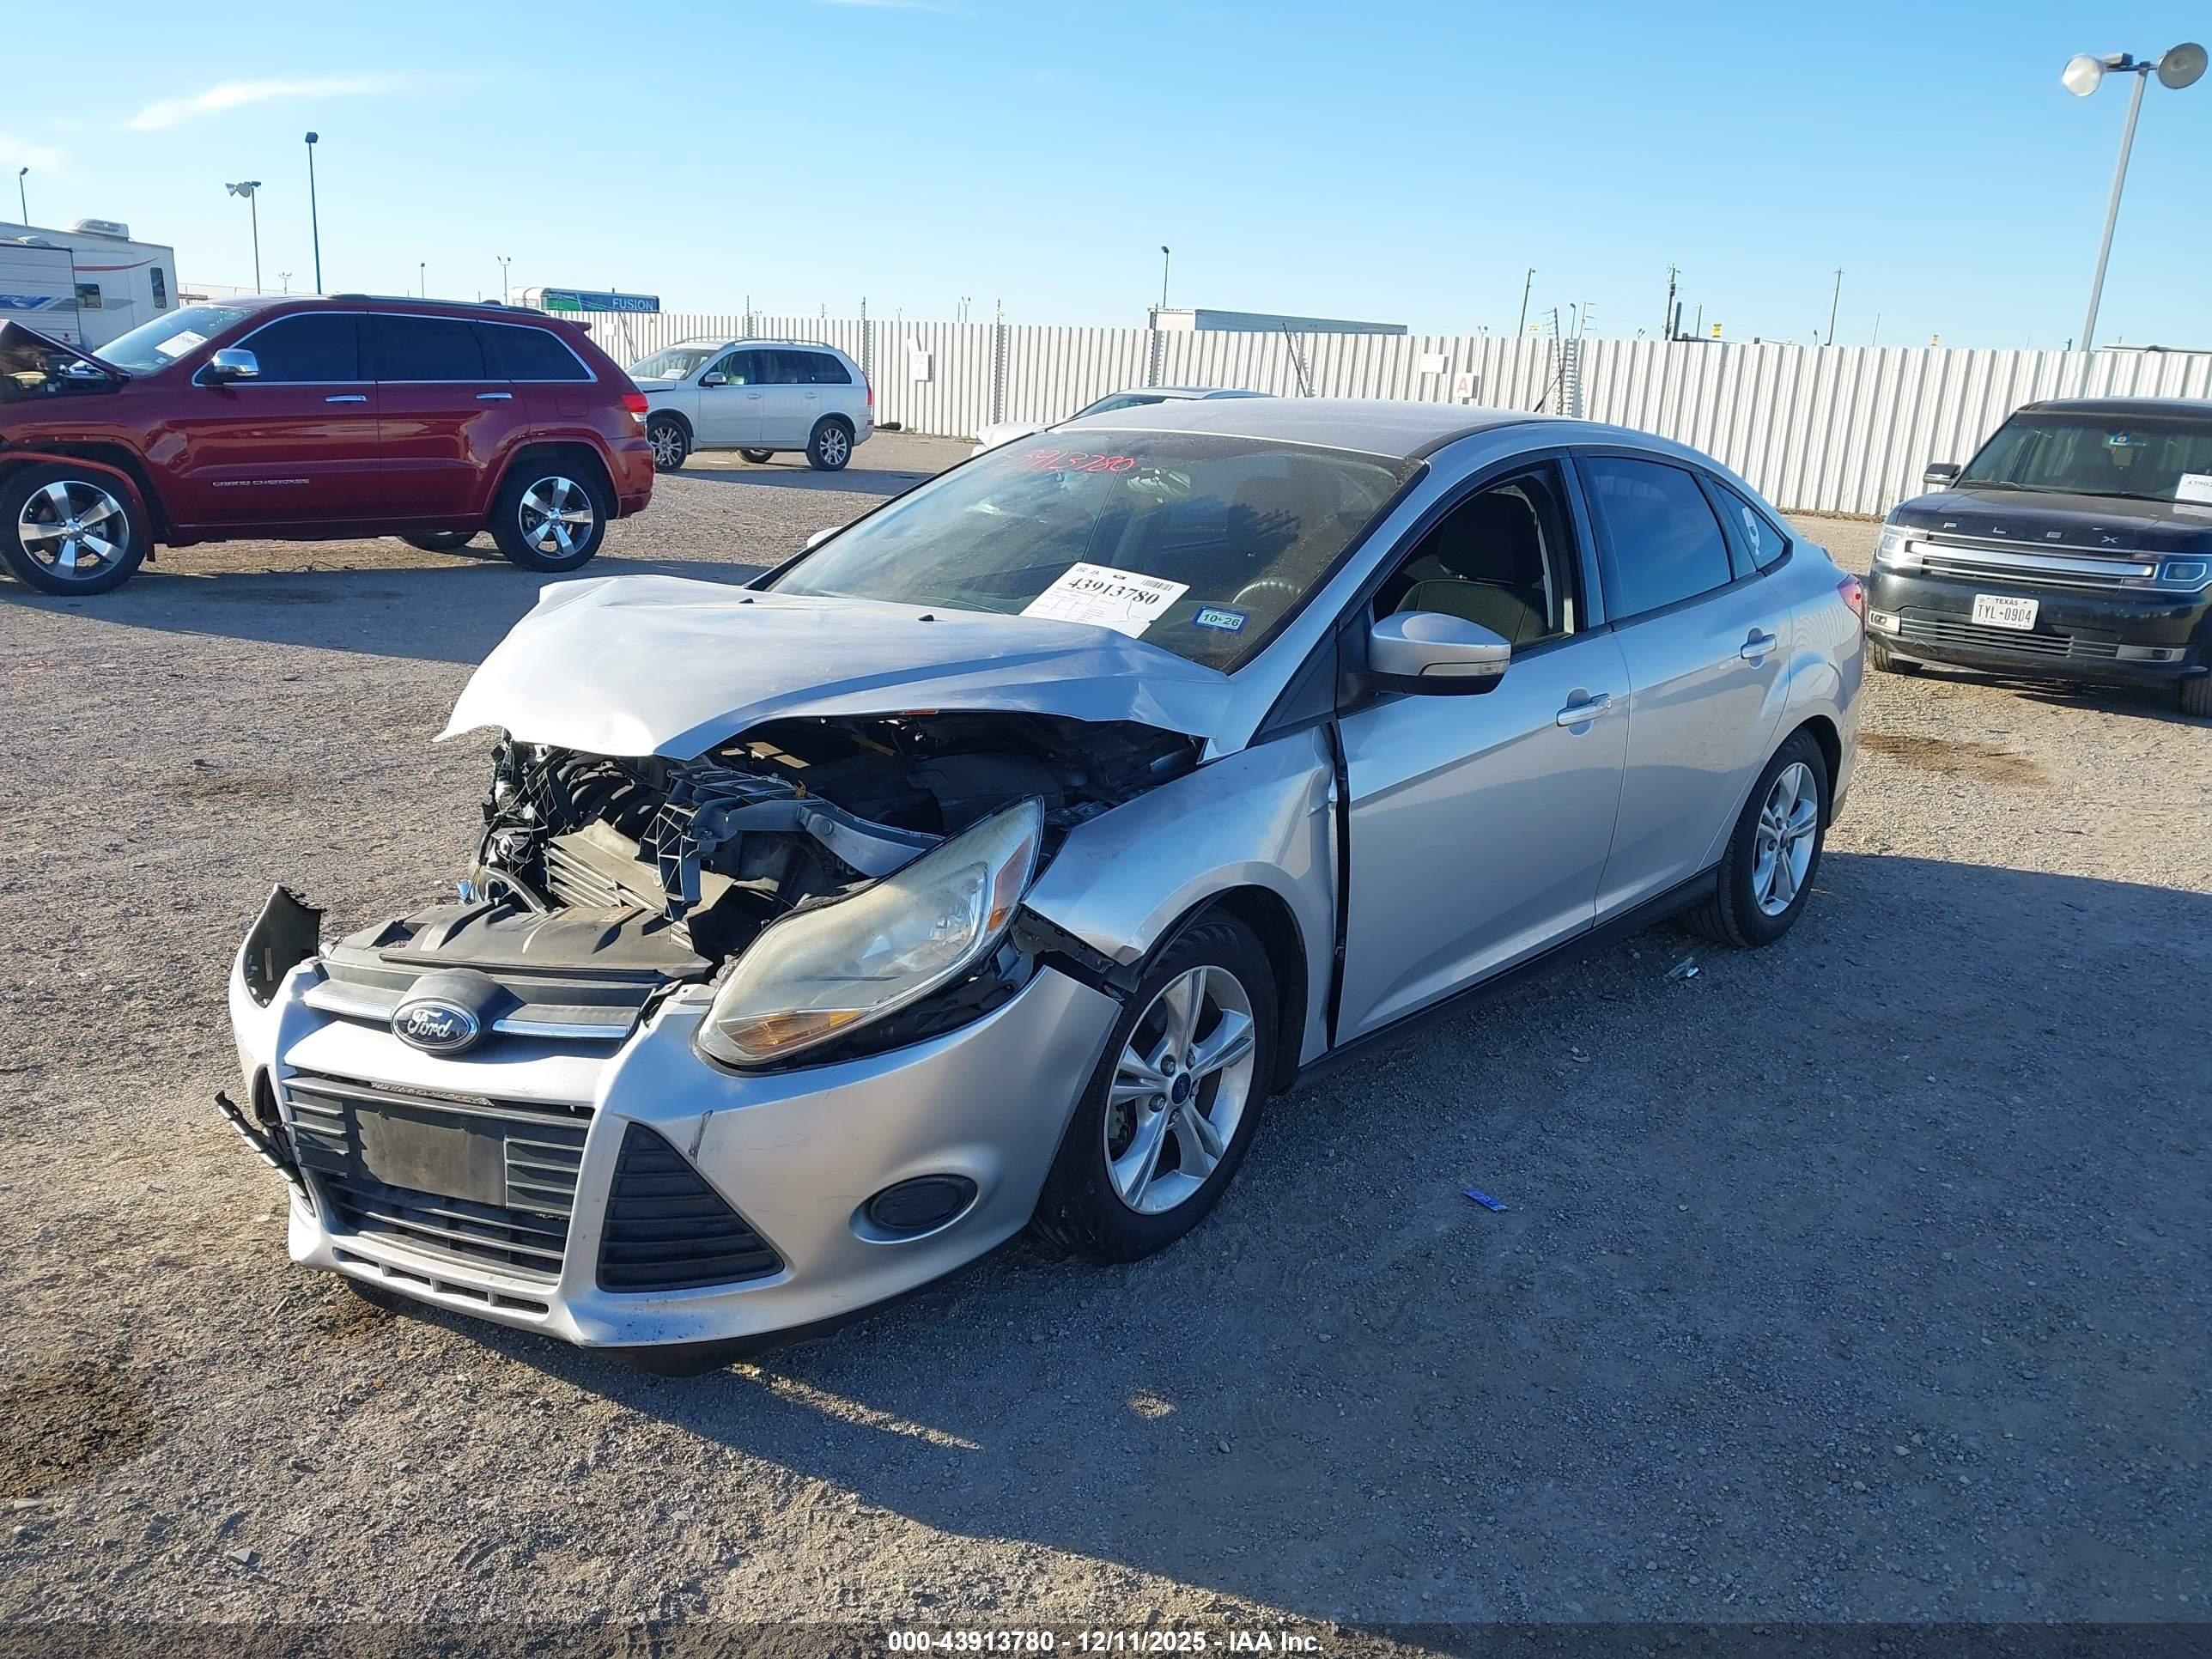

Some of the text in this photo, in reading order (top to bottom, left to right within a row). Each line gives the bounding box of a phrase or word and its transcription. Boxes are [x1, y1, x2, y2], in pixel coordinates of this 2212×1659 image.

[612, 298, 653, 311] FUSION
[1456, 376, 1468, 394] A
[1943, 521, 2119, 544] FLEX
[1067, 577, 1160, 605] 43913780
[406, 1008, 453, 1038] Ford
